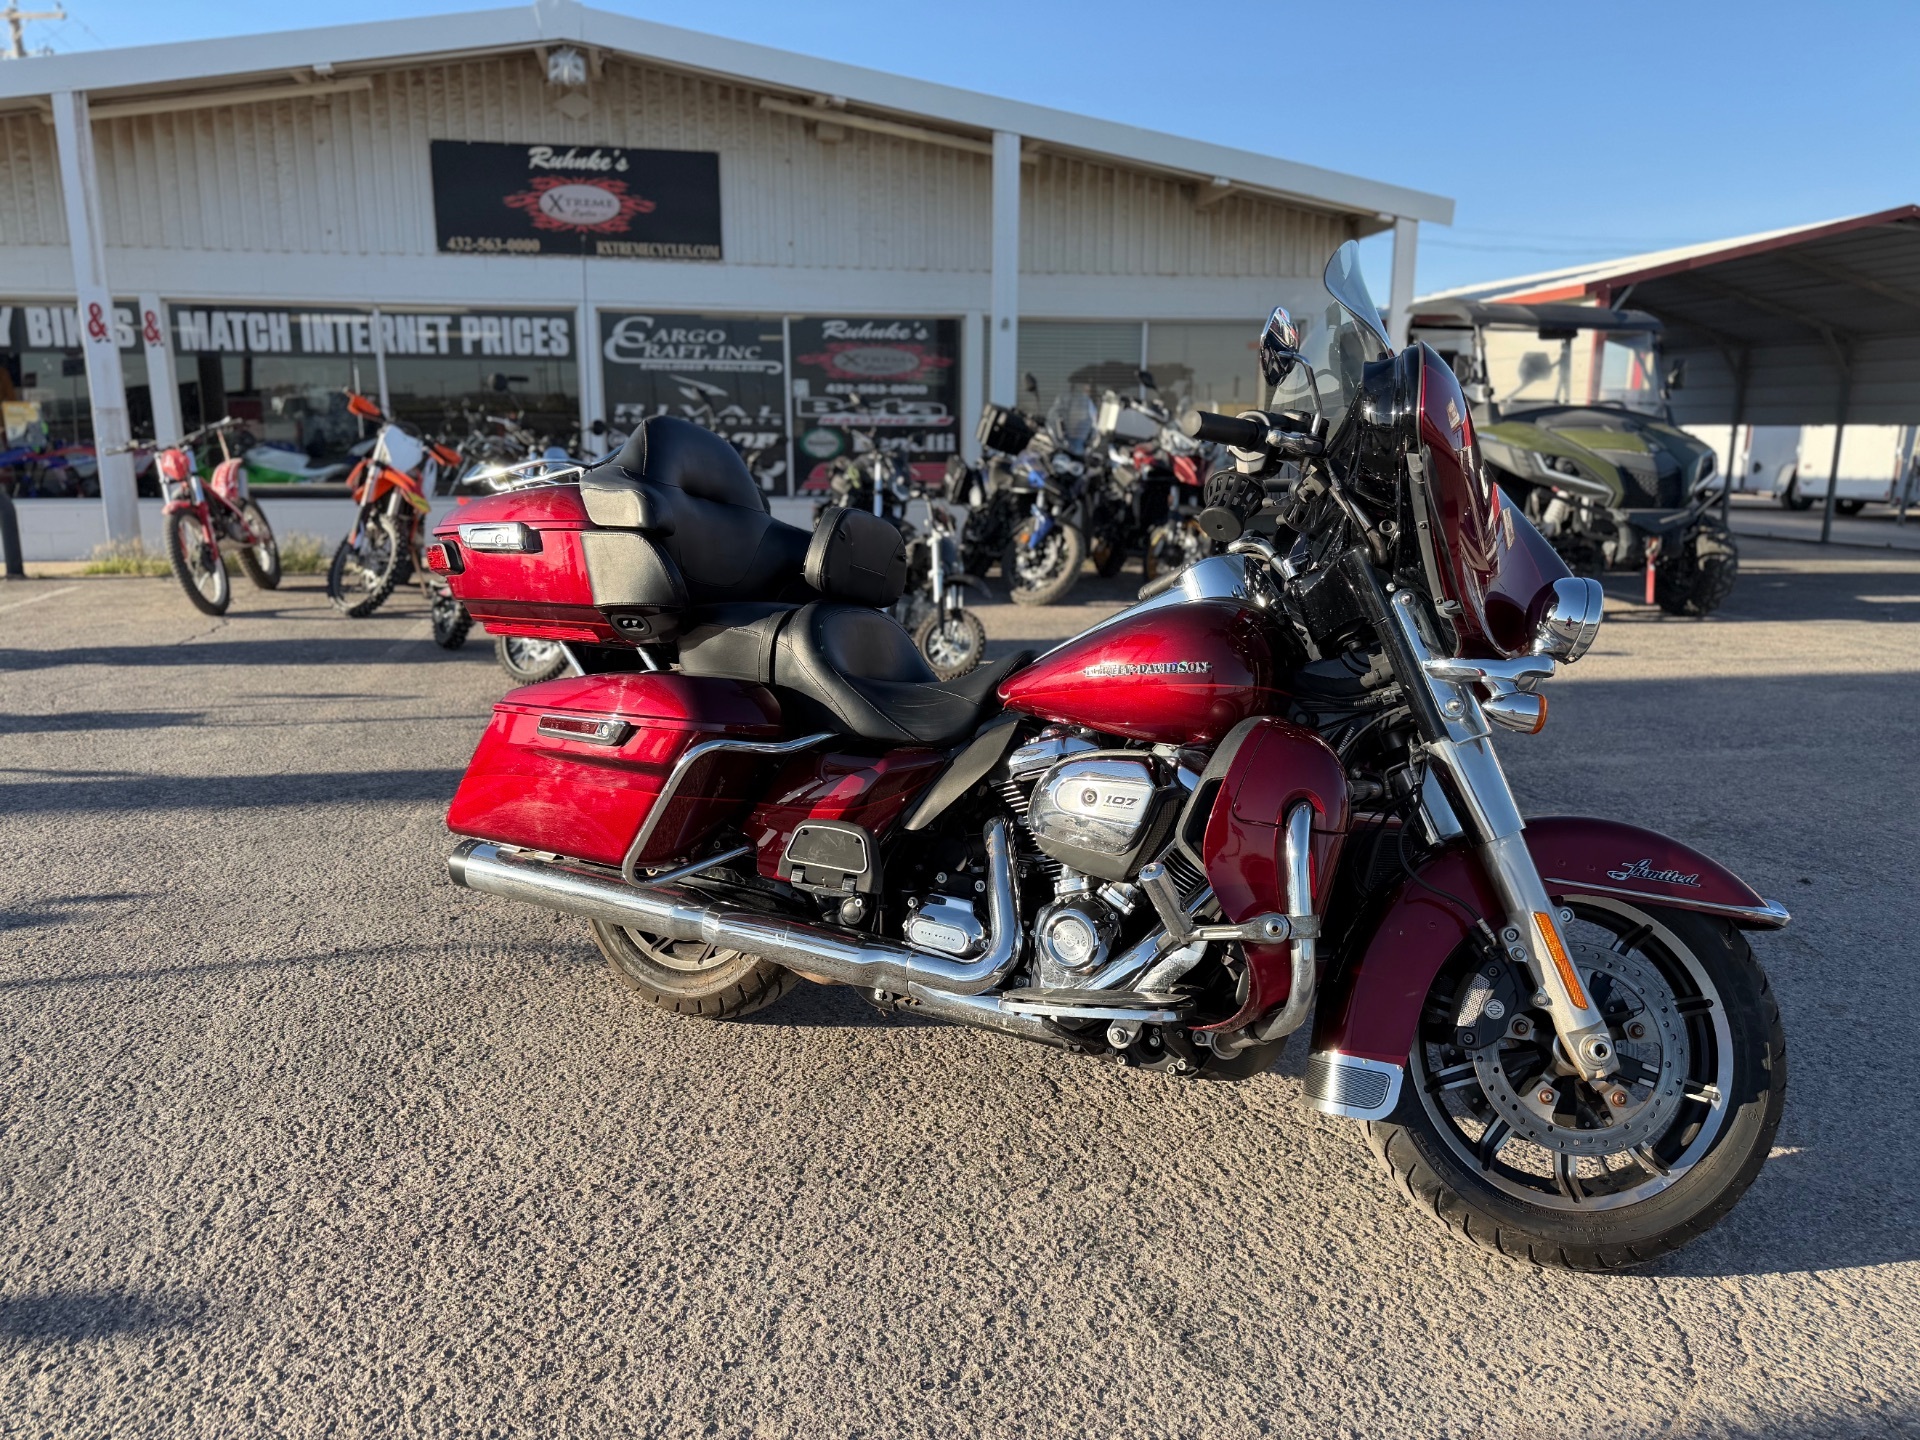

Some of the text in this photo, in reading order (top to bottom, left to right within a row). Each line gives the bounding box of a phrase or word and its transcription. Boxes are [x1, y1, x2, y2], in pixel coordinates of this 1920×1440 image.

[528, 146, 629, 171] Ruhnke's
[548, 193, 614, 213] XTREME
[178, 311, 570, 357] MATCH INTERNET PRICES
[822, 320, 929, 340] Ruhnke's
[717, 345, 762, 360] INC
[1607, 859, 1700, 887] Limited
